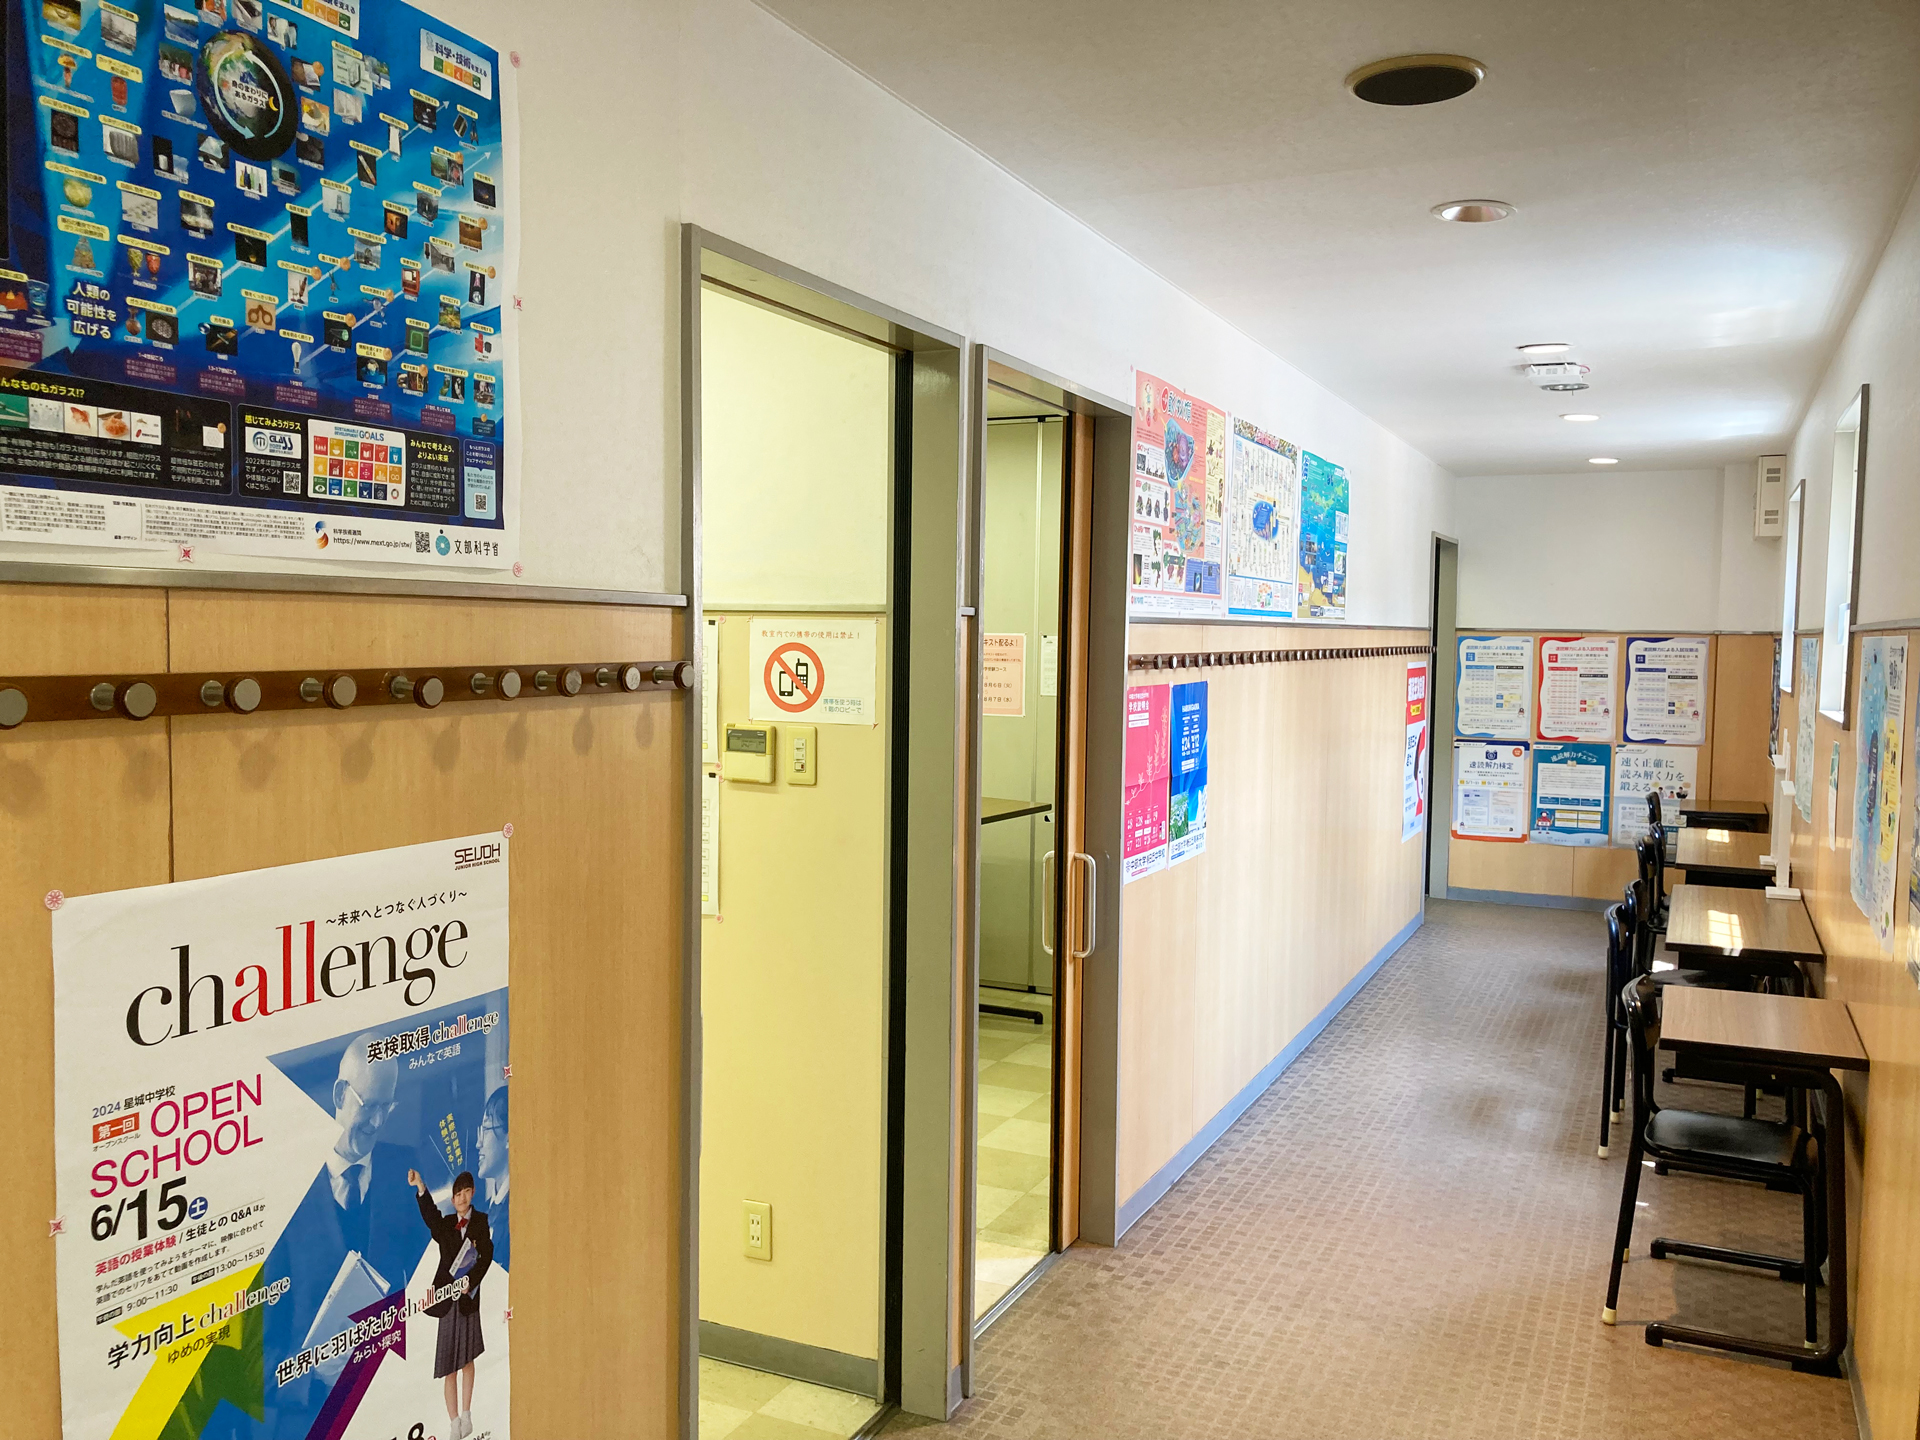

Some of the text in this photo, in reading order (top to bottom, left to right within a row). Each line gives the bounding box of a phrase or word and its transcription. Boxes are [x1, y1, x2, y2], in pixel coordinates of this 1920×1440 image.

[435, 42, 487, 78] 科学・技術を支える
[232, 80, 269, 99] 身のまわりに
[234, 91, 267, 108] あるガラス
[72, 282, 111, 301] 人類の
[65, 298, 117, 322] 可能性を
[73, 320, 112, 339] 広げる
[245, 414, 302, 431] 感じてみようガラス
[359, 430, 385, 442] GOALS
[417, 451, 449, 463] よりよい未来
[333, 536, 412, 549] https://www.mext.go.jp/stw/
[454, 539, 499, 557] 文部科学省
[1469, 761, 1514, 770] 速読解力検定
[1621, 757, 1674, 768] 速く正確に
[1620, 769, 1684, 781] 読み解く力を
[1620, 781, 1651, 792] 鍛える
[454, 843, 500, 865] SEIJOH
[454, 863, 471, 871] JUNIOR
[126, 917, 468, 1047] challenge
[366, 1011, 499, 1065] 英検取得 challenge
[408, 1042, 461, 1070] みんなで英語
[92, 1085, 176, 1119] 2024 星城中学校
[98, 1074, 262, 1140] 第一回 OPEN
[92, 1132, 141, 1152] オープンスクール
[90, 1115, 263, 1198] SCHOOL
[91, 1176, 206, 1242] 6/15 土
[107, 1276, 291, 1370] 学力向上 challenge
[276, 1275, 470, 1388] 世界に羽ばたけ challenge
[167, 1324, 231, 1365] ゆめの実現
[352, 1330, 402, 1364] みらい探究
